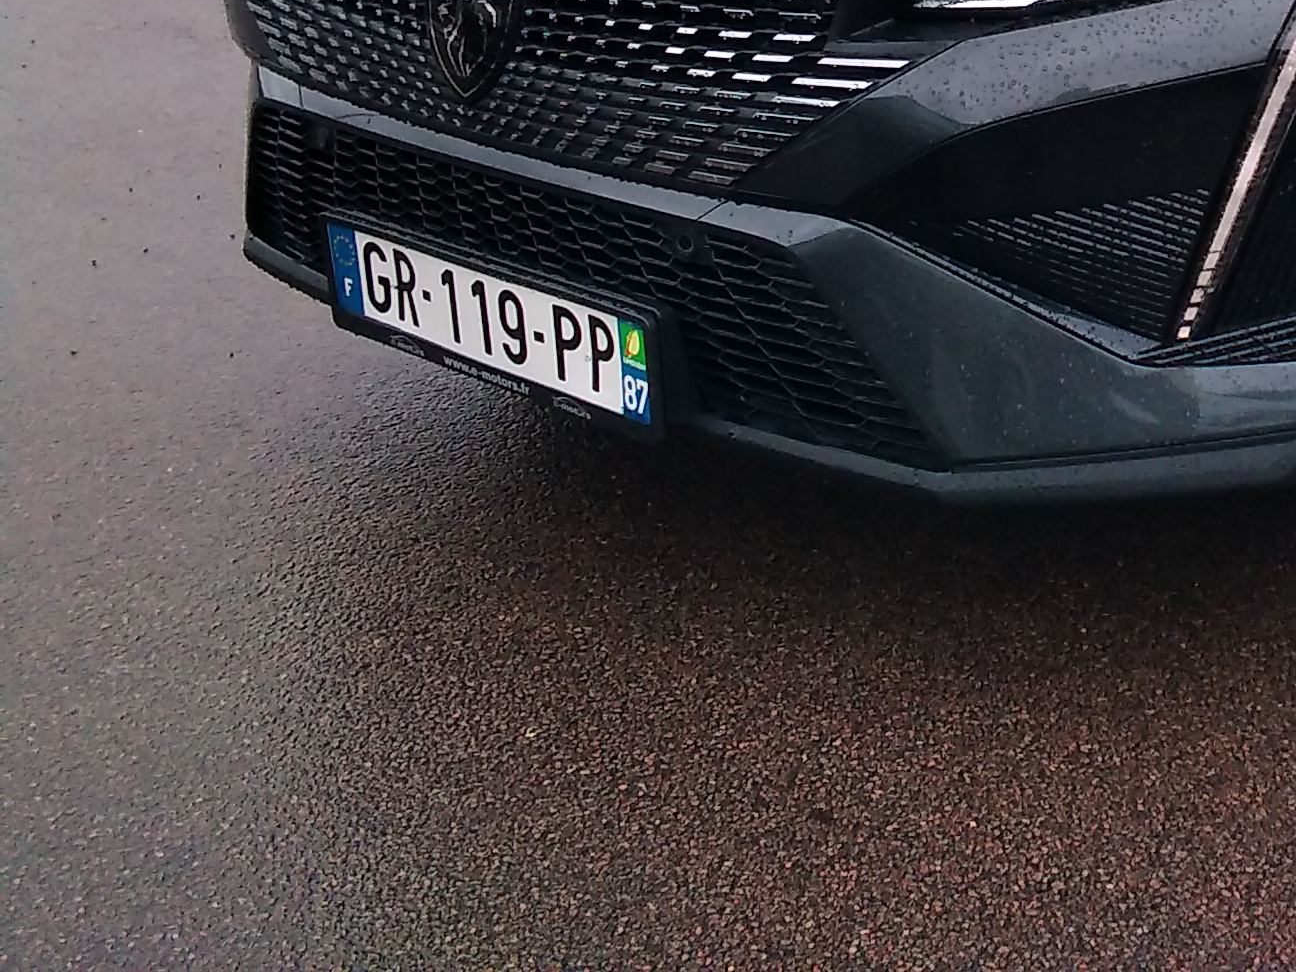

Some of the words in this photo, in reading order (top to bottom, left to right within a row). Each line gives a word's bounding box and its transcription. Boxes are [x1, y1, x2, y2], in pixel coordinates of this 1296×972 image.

[343, 276, 355, 298] F
[362, 240, 616, 393] GR-119-PP
[442, 354, 530, 396] www.e-motors.fr
[623, 375, 649, 415] 87
